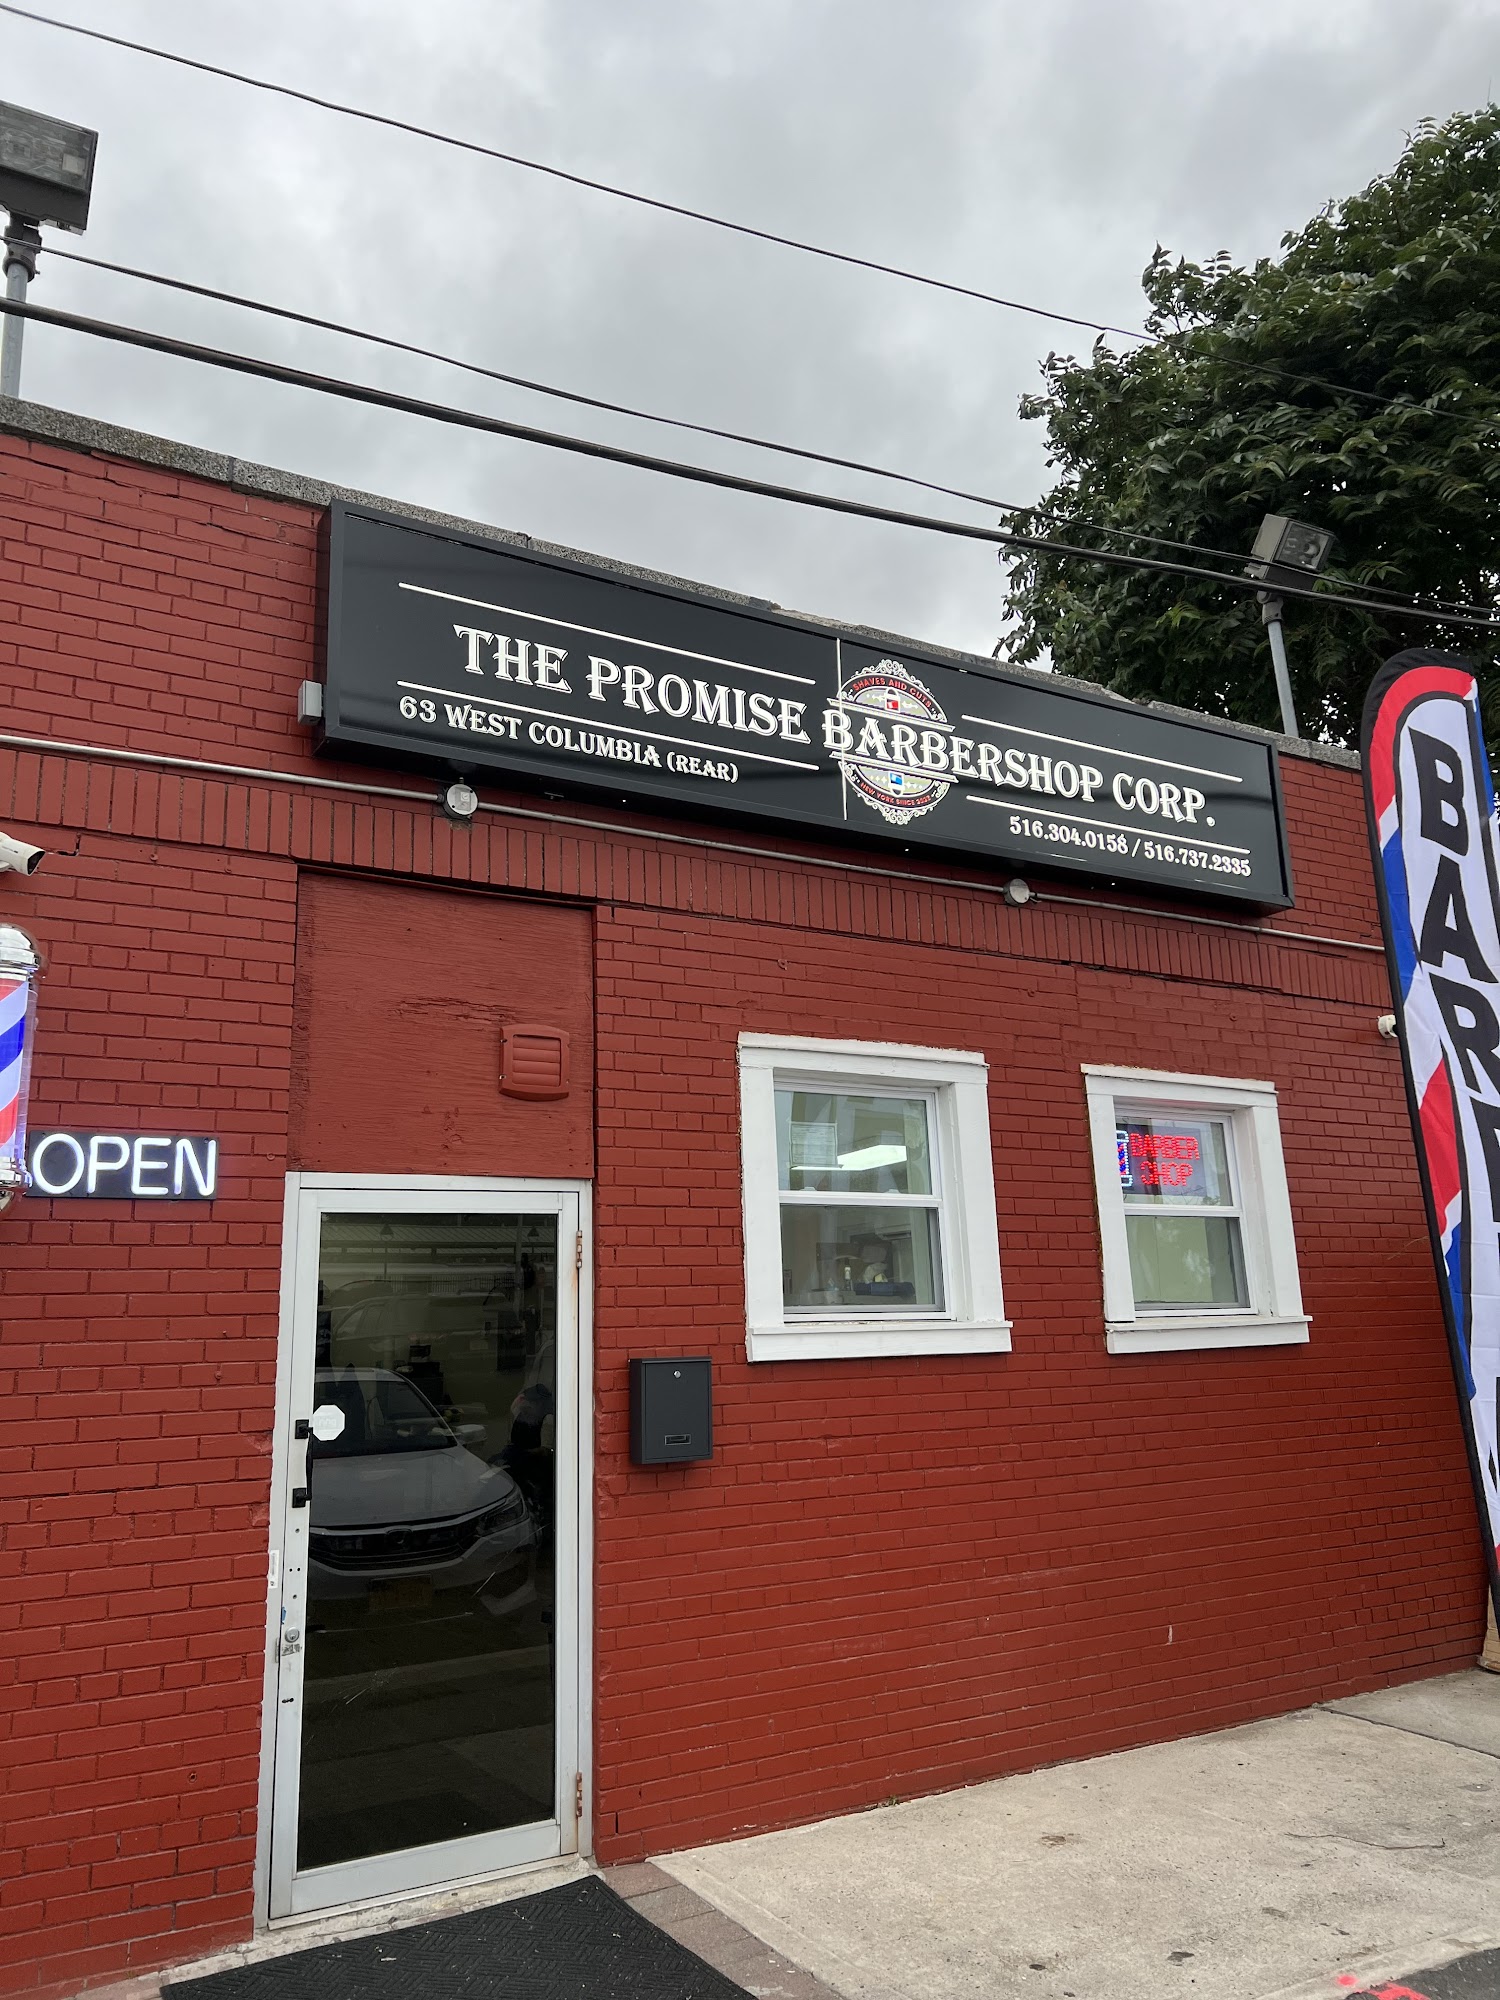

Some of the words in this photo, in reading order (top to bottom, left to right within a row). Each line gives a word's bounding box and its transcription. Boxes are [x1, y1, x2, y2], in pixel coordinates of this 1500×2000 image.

[852, 677, 886, 691] SHAVES
[888, 679, 907, 691] AND
[910, 688, 932, 708] CUTS
[399, 695, 437, 723] 63
[444, 703, 522, 740] WEST
[529, 722, 663, 768] COLUMBIA
[666, 751, 739, 783] (REAR)
[454, 624, 572, 693] THE
[586, 655, 811, 744] PROMISE
[822, 708, 1103, 802] BARBERSHOP
[1113, 772, 1216, 827] CORP.
[860, 782, 875, 795] NEW
[877, 792, 894, 803] YORK
[1009, 815, 1129, 854] 516.304.0158
[1131, 838, 1141, 857] /
[1144, 841, 1251, 876] 516.737.2335
[32, 1133, 217, 1196] OPEN
[1130, 1133, 1200, 1160] BARBER
[1140, 1160, 1193, 1186] SHOP
